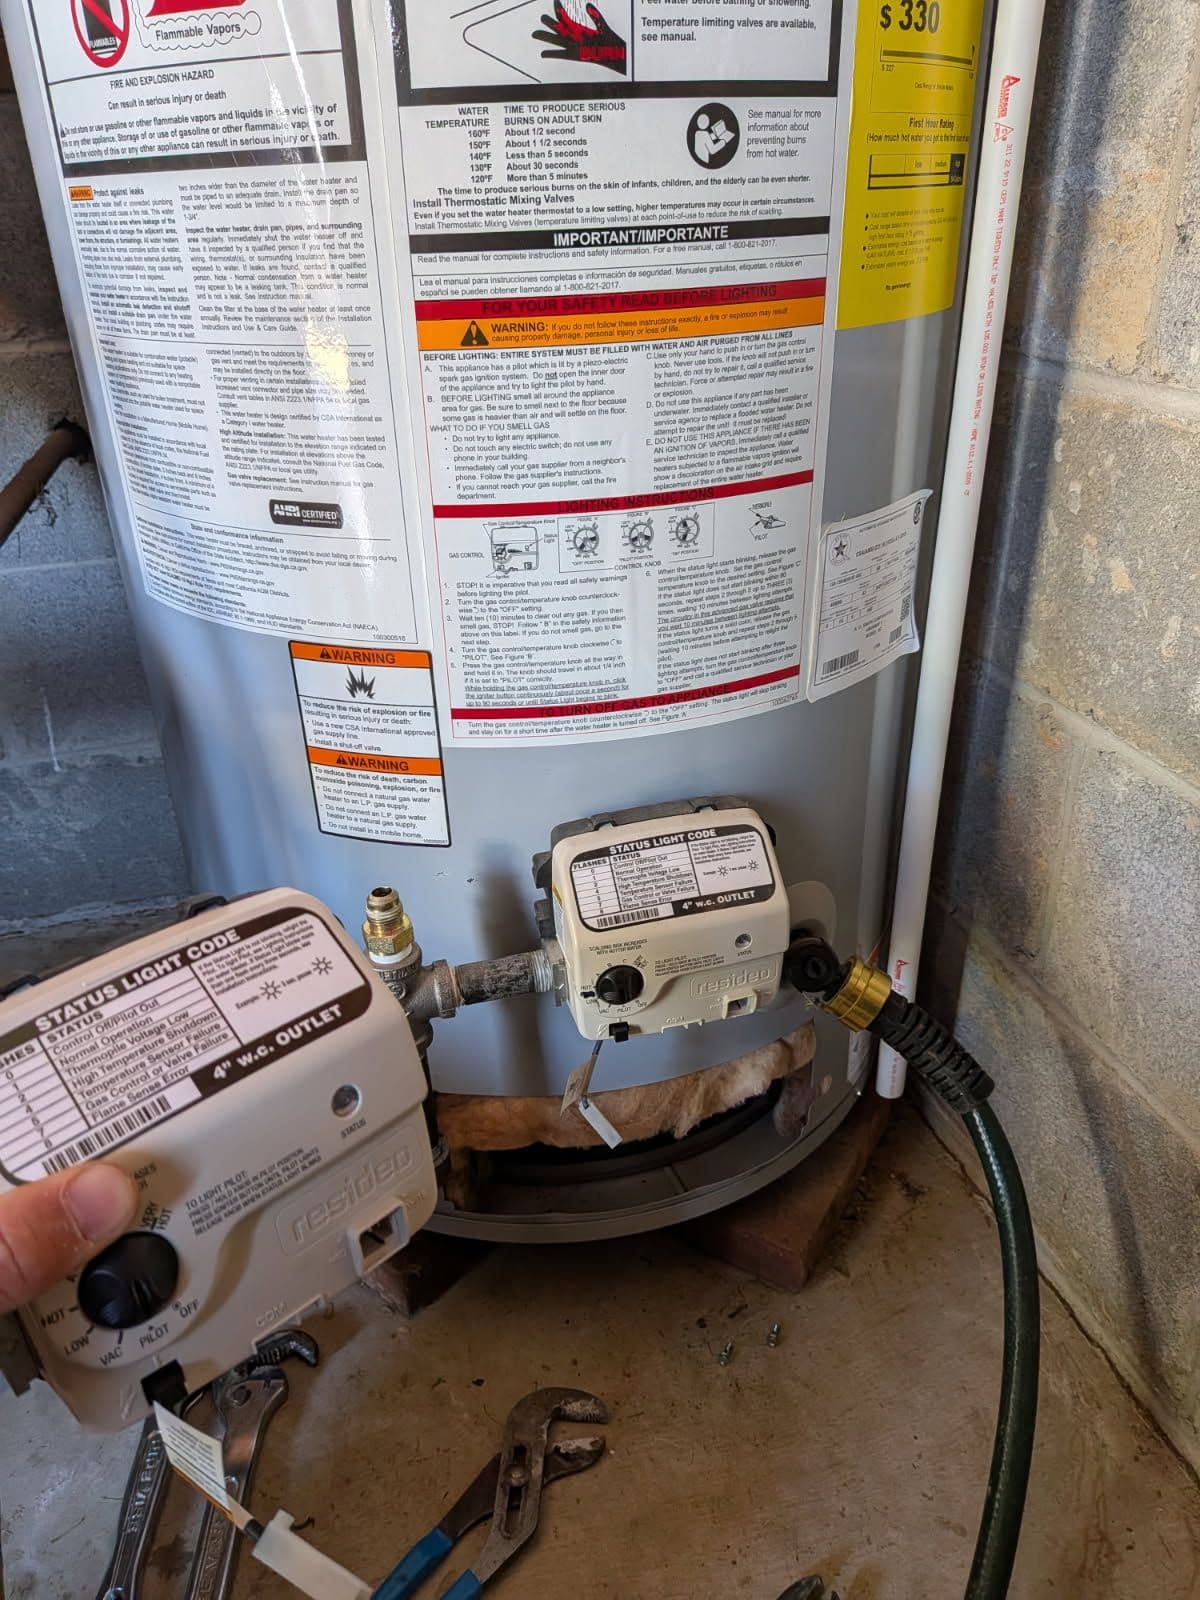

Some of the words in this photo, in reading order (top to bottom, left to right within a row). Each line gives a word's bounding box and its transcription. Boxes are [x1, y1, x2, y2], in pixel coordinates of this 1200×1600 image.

[641, 17, 699, 29] Temperature
[701, 17, 734, 29] limiting
[736, 17, 763, 27] valves
[765, 20, 778, 28] are
[780, 19, 816, 30] available,
[880, 4, 892, 30] $
[898, 0, 940, 34] 330
[155, 25, 203, 40] Flammable
[206, 23, 241, 37] Vapors
[641, 33, 657, 41] see
[660, 32, 696, 41] manual.
[110, 79, 123, 89] FIRE
[125, 77, 138, 87] AND
[139, 73, 180, 86] EXPLOSION
[181, 69, 214, 81] HAZARD
[108, 101, 119, 110] Can
[120, 99, 137, 108] result
[138, 98, 144, 106] in
[145, 96, 171, 106] serious
[171, 94, 192, 105] injury
[194, 93, 203, 101] or
[204, 90, 226, 100] death
[503, 105, 524, 113] TIME
[527, 104, 539, 113] TO
[542, 103, 585, 112] PRODUCE
[588, 102, 625, 111] SERIOUS
[458, 106, 489, 115] WATER
[504, 116, 534, 125] BURNS
[536, 116, 550, 124] ON
[551, 115, 580, 124] ADULT
[582, 114, 602, 123] SKIN
[747, 110, 763, 118] See
[765, 109, 791, 118] manual
[793, 109, 803, 118] for
[804, 110, 821, 118] more
[425, 118, 489, 128] TEMPERATURE
[505, 128, 529, 136] About
[532, 127, 543, 135] 1/2
[545, 126, 575, 135] second
[747, 122, 787, 131] information
[789, 122, 809, 131] about
[909, 117, 924, 129] First
[939, 119, 955, 130] Rating
[532, 139, 536, 147] 1
[539, 138, 551, 146] 1/2
[553, 138, 587, 146] seconds
[746, 136, 785, 146] preventing
[786, 135, 806, 144] burns
[505, 151, 525, 159] Less
[547, 149, 552, 158] 5
[554, 148, 588, 157] seconds
[746, 149, 763, 158] from
[765, 148, 777, 158] hot
[778, 149, 799, 157] water.
[506, 162, 531, 170] About
[533, 161, 542, 170] 30
[544, 160, 578, 169] seconds
[529, 173, 547, 181] than
[549, 172, 554, 180] 5
[556, 172, 588, 180] minutes
[413, 198, 441, 208] Install
[443, 196, 506, 207] Thermostatic
[509, 195, 541, 206] Mixing
[543, 194, 574, 203] Valves
[553, 225, 728, 246] IMPORTANT/IMPORTANTE
[482, 301, 512, 313] FOR
[516, 299, 557, 312] YOUR
[562, 295, 617, 310] SAFETY
[620, 293, 659, 306] READ
[663, 289, 717, 304] BEFORE
[720, 285, 776, 300] LIGHTING
[491, 322, 548, 333] WARNING:
[429, 424, 451, 432] WHAT
[487, 423, 505, 431] YOU
[506, 422, 532, 431] SMELL
[533, 421, 550, 429] GAS
[302, 509, 337, 520] CERTIFIED
[332, 649, 396, 665] WARNING
[312, 702, 335, 710] reduce
[372, 708, 407, 716] explosion
[348, 756, 409, 772] WARNING
[609, 840, 650, 854] STATUS
[652, 833, 684, 848] LIGHT
[687, 828, 716, 840] CODE
[612, 852, 640, 862] STATUS
[695, 899, 716, 908] w.c.
[717, 890, 756, 905] OUTLET
[35, 987, 120, 1033] STATUS
[123, 956, 182, 990] LIGHT
[188, 931, 240, 960] CODE
[697, 969, 771, 995] resideo
[46, 1011, 103, 1043] STATUS
[52, 1029, 94, 1055] Control
[95, 1008, 138, 1034] Off/Pilot
[139, 997, 159, 1012] Out
[237, 1047, 275, 1067] w.c.
[275, 1004, 343, 1046] OUTLET
[59, 1041, 99, 1067] Normal
[100, 1017, 153, 1047] Operation
[64, 1043, 126, 1077] Thermopile
[126, 1023, 166, 1046] Voltage
[166, 1011, 189, 1026] Low
[71, 1071, 99, 1090] High
[98, 1038, 165, 1075] Temperature
[165, 1011, 217, 1040] Shutdown
[78, 1061, 146, 1099] Temperature
[147, 1041, 184, 1063] Sensor
[185, 1023, 220, 1044] Failure
[85, 1095, 109, 1110] Gas
[109, 1070, 150, 1098] Control
[152, 1065, 163, 1076] or
[163, 1051, 193, 1068] Valve
[193, 1033, 228, 1054] Failure
[91, 1100, 126, 1121] Flame
[126, 1081, 161, 1102] Sense
[161, 1065, 190, 1084] Error
[185, 1199, 198, 1210] TO
[198, 1185, 222, 1204] LIGHT
[223, 1173, 249, 1191] PILOT:
[288, 1150, 412, 1243] resideo
[142, 1202, 159, 1228] VERY
[158, 1209, 173, 1231] HOT
[40, 1309, 66, 1329] HOT
[179, 1300, 201, 1320] OFF
[63, 1334, 90, 1356] LOW
[138, 1323, 171, 1351] PILOT
[99, 1346, 124, 1368] VAC
